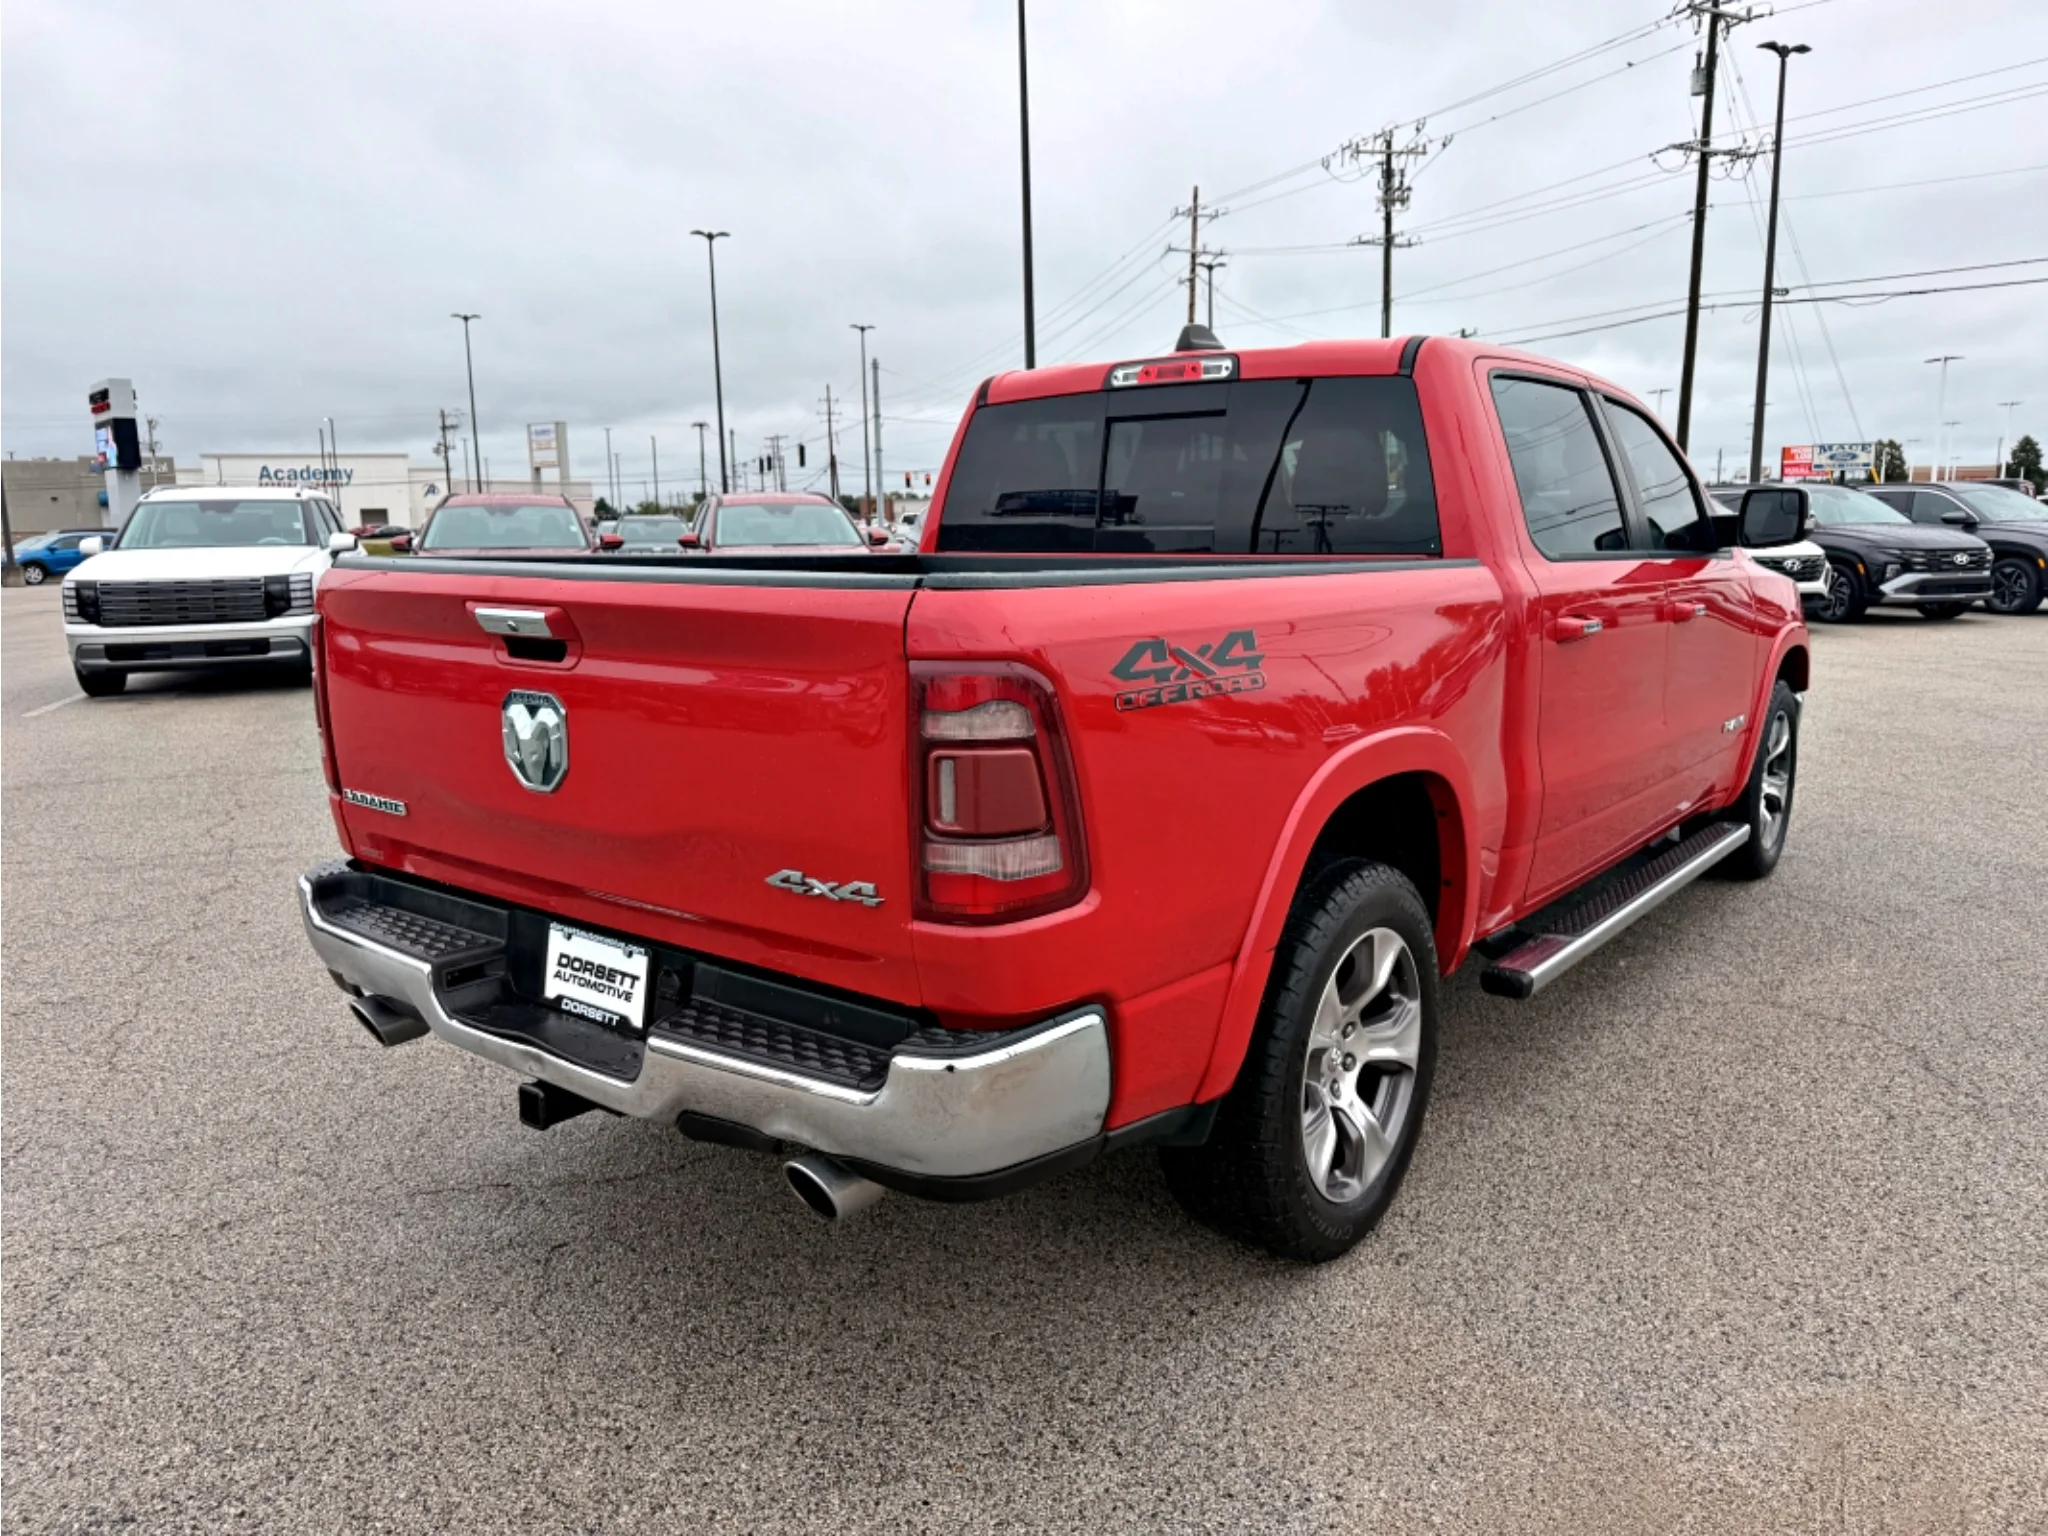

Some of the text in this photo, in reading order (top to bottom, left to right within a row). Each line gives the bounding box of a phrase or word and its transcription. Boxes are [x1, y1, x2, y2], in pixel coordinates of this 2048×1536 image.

[259, 464, 353, 486] Academy
[1117, 672, 1264, 710] OFF ROAD
[554, 969, 633, 1003] AUTOMOTIVE
[557, 952, 641, 989] DORSETT
[561, 998, 620, 1026] DORSETT
